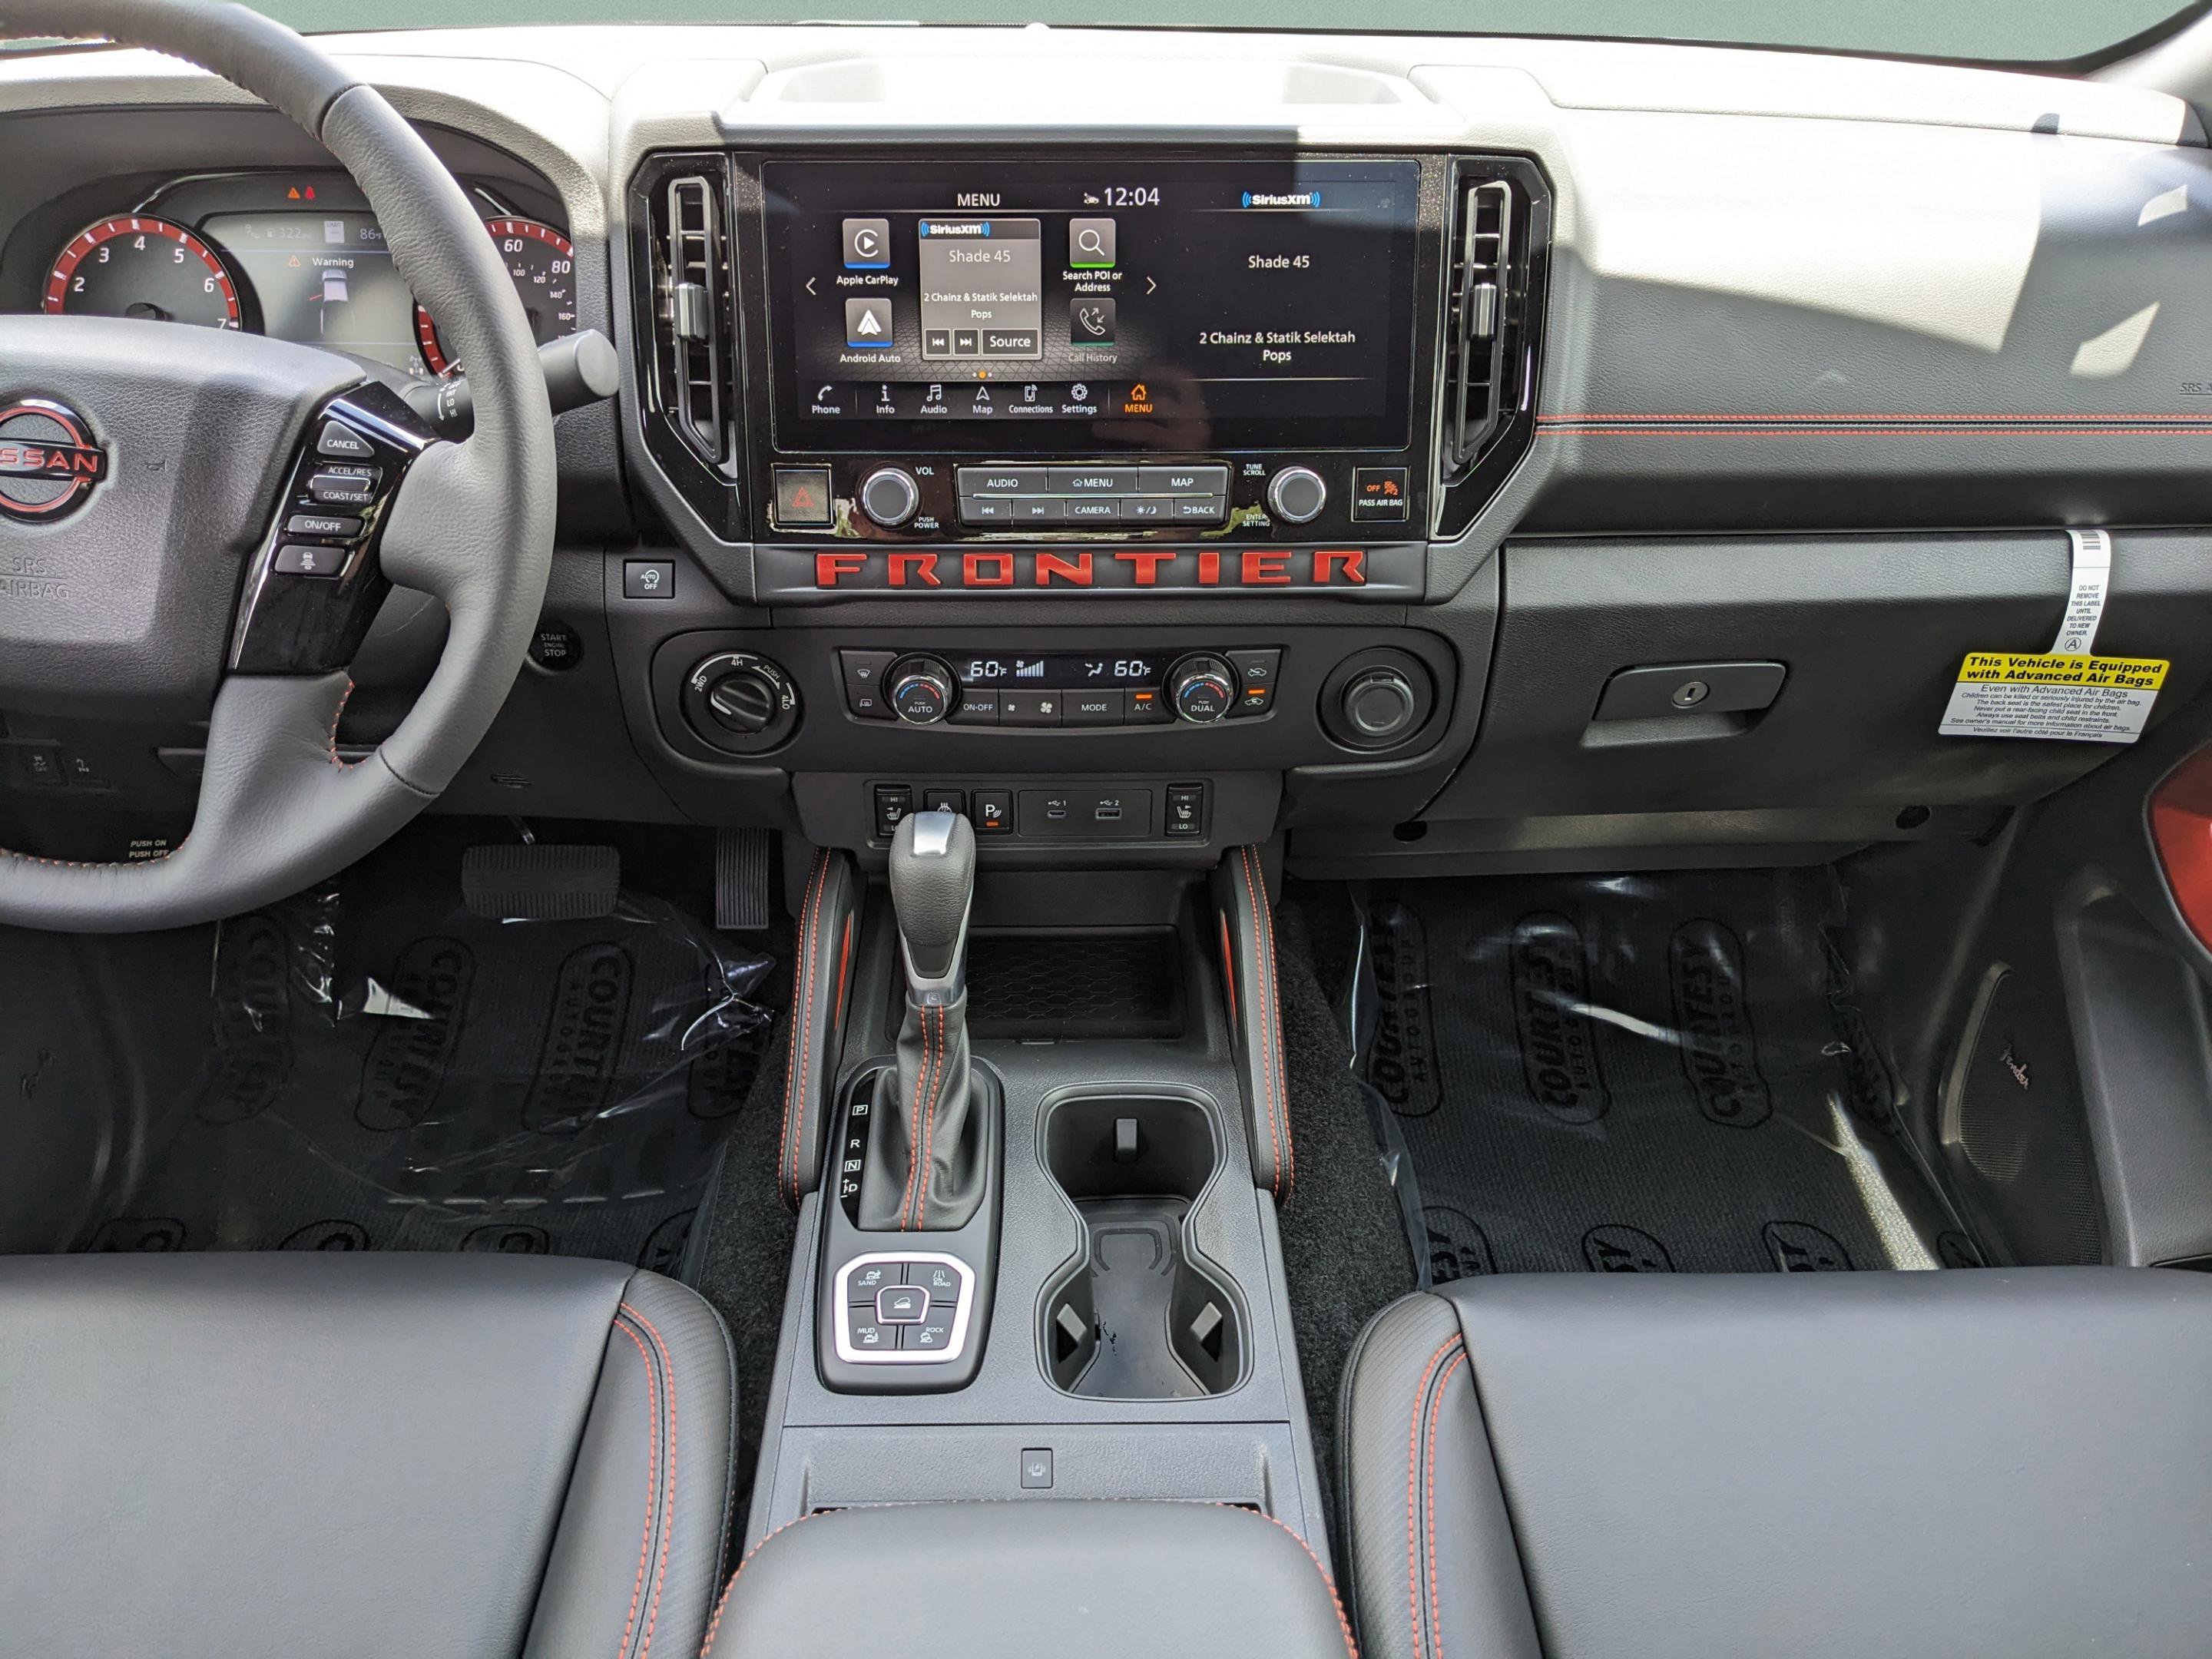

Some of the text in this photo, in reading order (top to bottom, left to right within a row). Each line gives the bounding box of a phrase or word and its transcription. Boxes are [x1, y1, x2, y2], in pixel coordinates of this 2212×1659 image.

[957, 194, 1000, 207] MENU
[1104, 187, 1161, 207] 12:04
[134, 236, 145, 250] 4
[504, 239, 523, 253] 60
[99, 247, 110, 263] 3
[174, 248, 184, 264] 5
[949, 249, 1011, 263] Shade 45
[312, 257, 354, 269] Warning
[1248, 255, 1310, 268] Shade 45
[513, 268, 525, 276] 100
[551, 260, 571, 274] 80
[533, 275, 546, 283] 120
[836, 276, 899, 286] Apple CarPlay
[1062, 271, 1122, 281] Search POI or
[75, 277, 85, 292] 2
[204, 278, 214, 293] 6
[1075, 283, 1111, 293] Address
[550, 291, 562, 300] 140
[924, 293, 1038, 302] 2 Chainz & Statik Selektah
[971, 310, 992, 320] Pops
[990, 336, 1031, 347] Source
[1199, 331, 1355, 344] 2 Chainz & Statik Selektah
[840, 354, 901, 363] Android Auto
[1068, 354, 1118, 364] Call History
[1263, 350, 1291, 363] Pops
[446, 399, 455, 407] LO
[812, 406, 840, 414] Phone
[876, 406, 895, 414] Info
[921, 406, 947, 414] Audio
[972, 406, 993, 416] Map
[1008, 405, 1053, 413] Connections
[1061, 405, 1098, 416] Settings
[1124, 404, 1153, 413] MENU
[327, 439, 359, 449] CANCEL
[328, 467, 372, 476] ACCEL/RES
[916, 467, 934, 475] VOL
[987, 478, 1018, 488] AUDIO
[1084, 478, 1113, 487] MENU
[1171, 478, 1194, 487] MAP
[323, 492, 368, 501] COAST/SET
[1075, 506, 1111, 515] CAMERA
[1192, 505, 1214, 515] BACK
[305, 521, 341, 531] ON/OFF
[816, 553, 1367, 585] FRONTIER
[541, 634, 565, 642] START
[731, 659, 743, 667] 4H
[1969, 657, 2163, 674] This Vehicle is Equipped
[763, 664, 780, 680] PUSH
[694, 675, 707, 692] 2WD
[1967, 670, 2154, 687] with Advanced Air Bags
[2032, 686, 2083, 696] Advanced
[2101, 689, 2128, 699] Bags
[780, 694, 790, 710] 4LO
[1134, 703, 1152, 711] A/C
[850, 1140, 860, 1148] R
